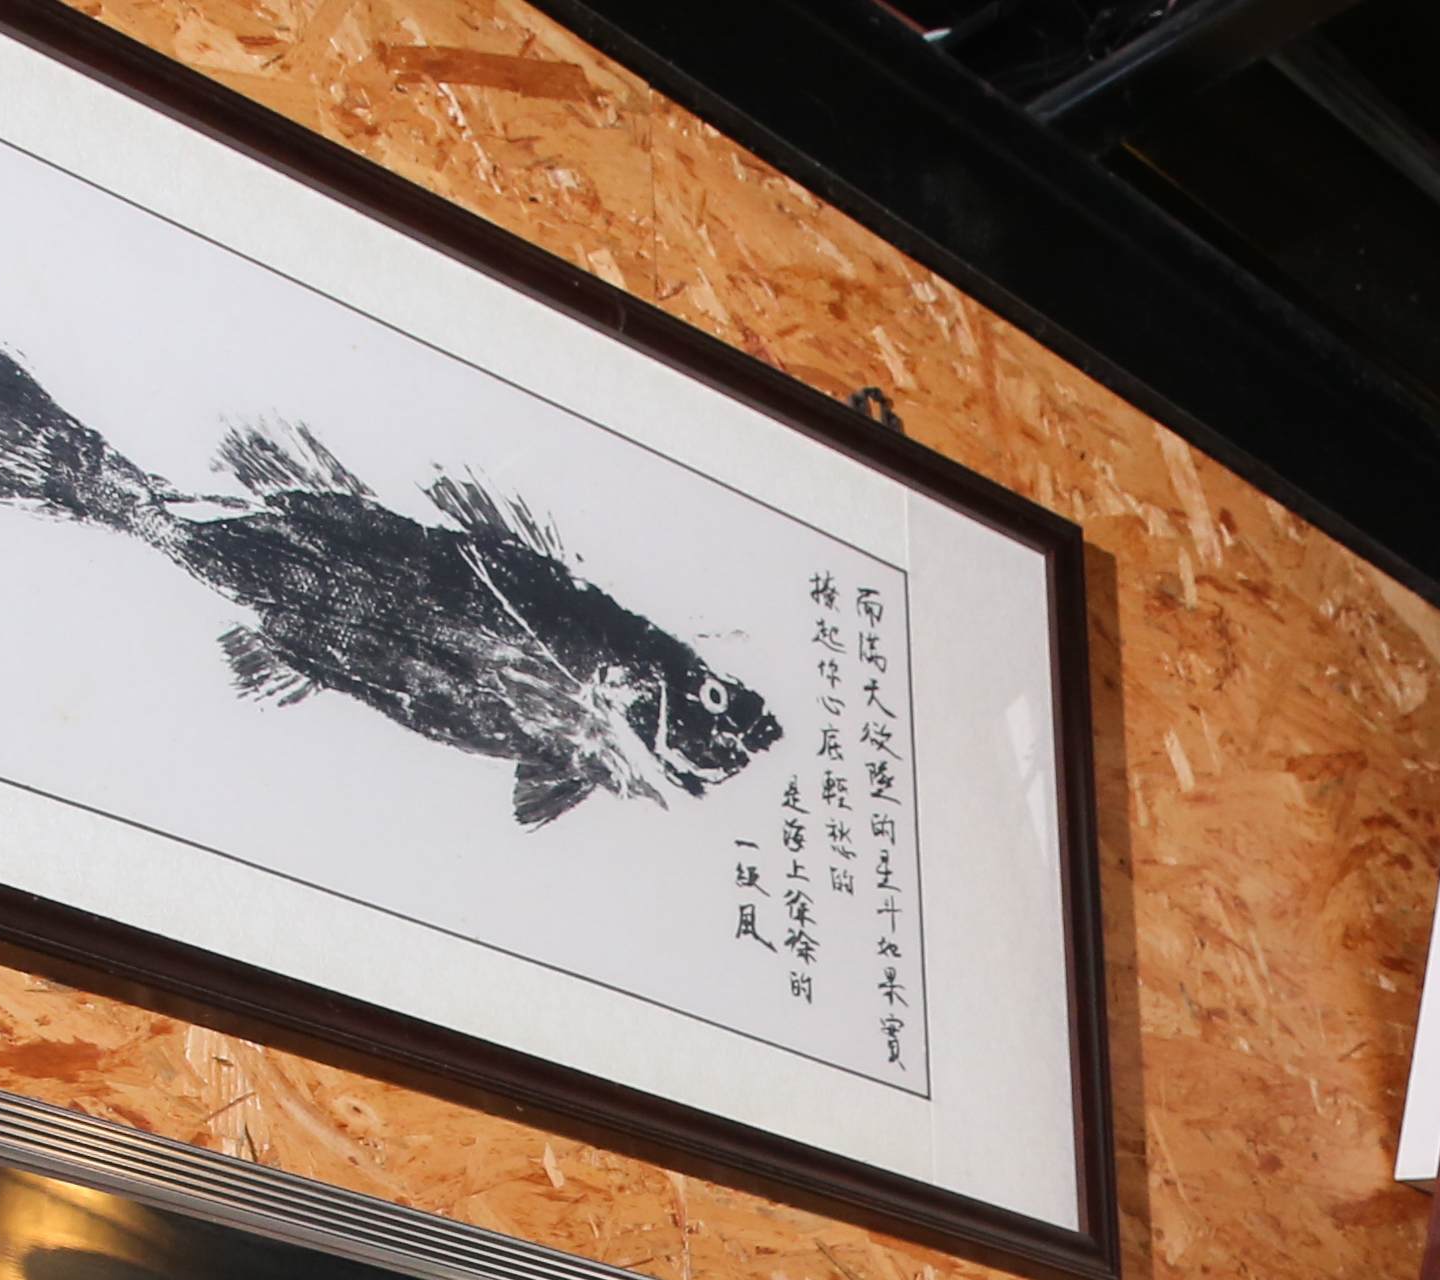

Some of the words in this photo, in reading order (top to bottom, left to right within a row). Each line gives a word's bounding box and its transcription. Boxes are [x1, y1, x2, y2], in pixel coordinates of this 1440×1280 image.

[809, 570, 857, 897] 撩起你心底輕愁的
[733, 838, 778, 953] 一級風
[781, 774, 820, 1004] 是海上徐徐的
